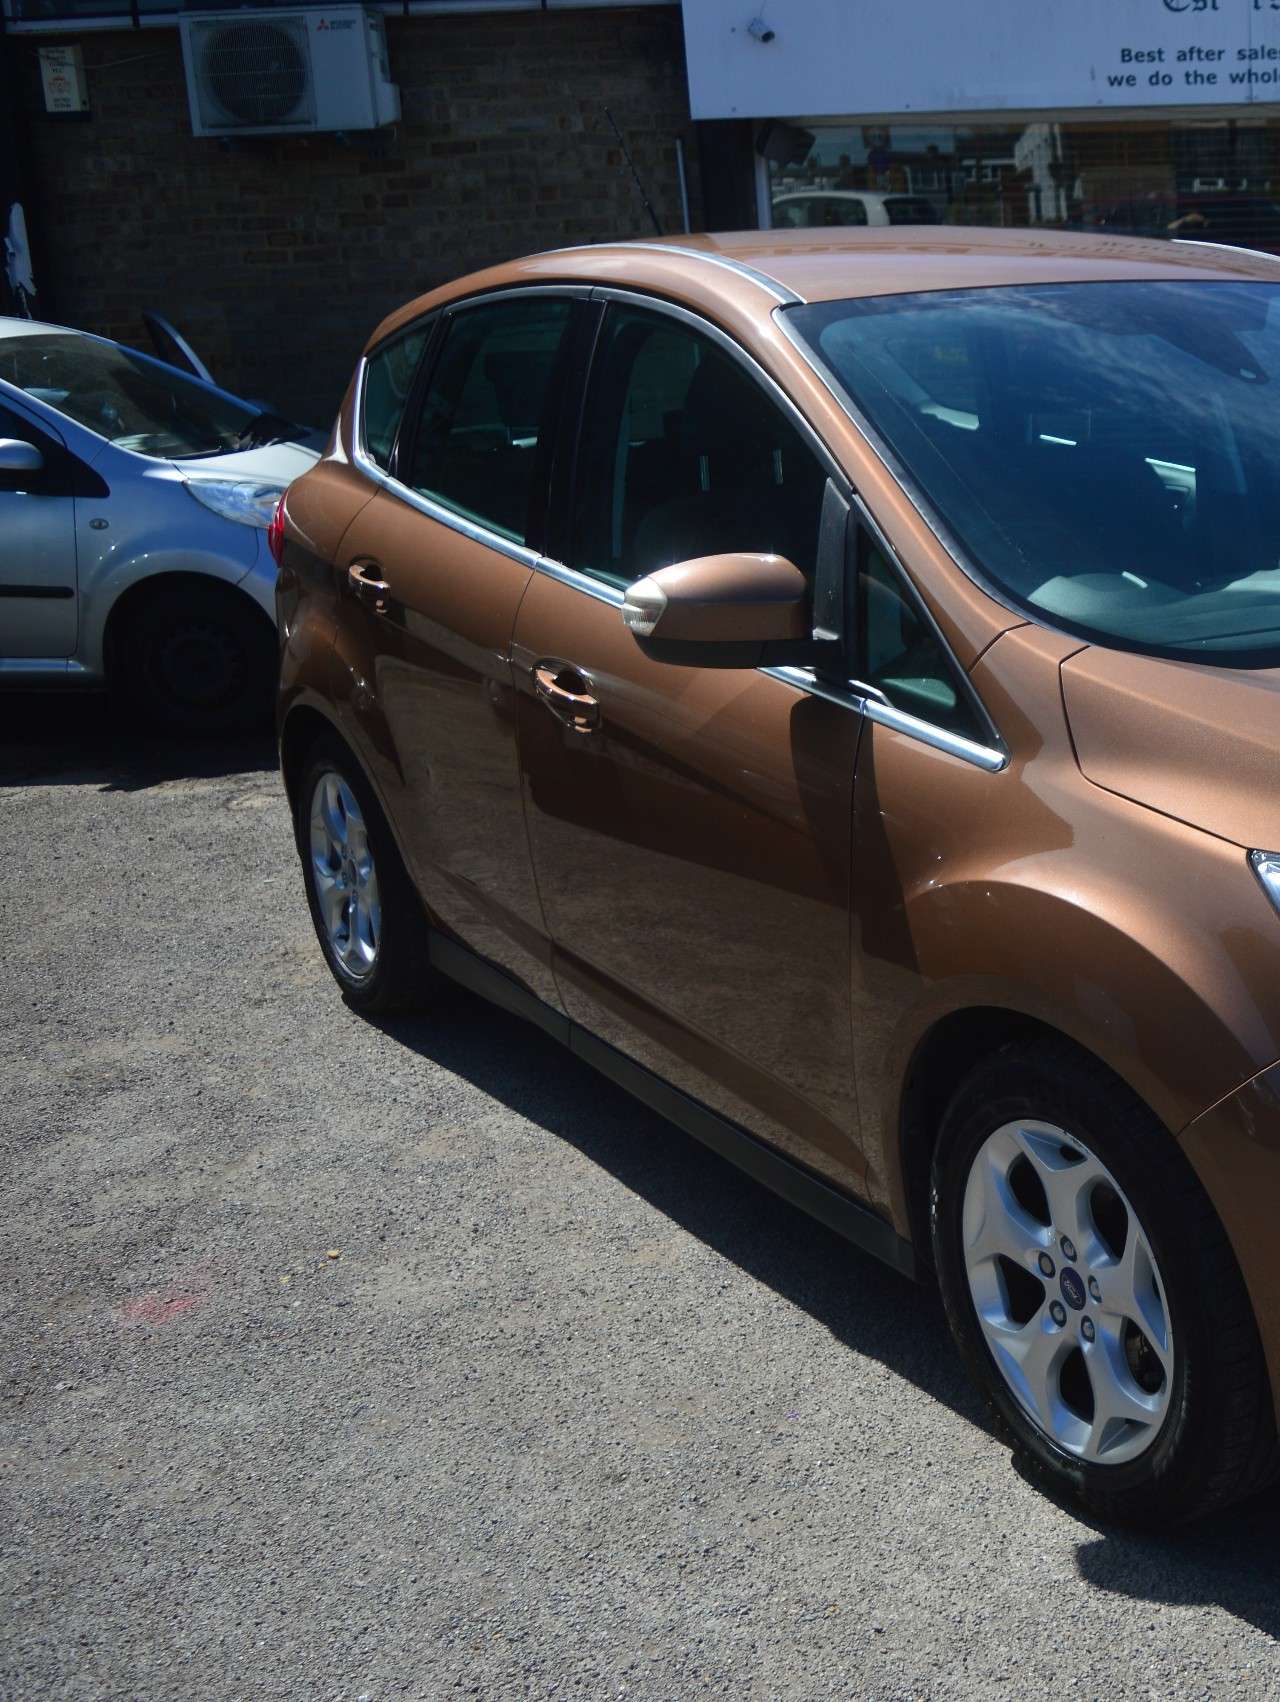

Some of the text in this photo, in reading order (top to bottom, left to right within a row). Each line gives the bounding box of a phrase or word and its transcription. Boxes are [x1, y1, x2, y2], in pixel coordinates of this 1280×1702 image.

[1120, 47, 1165, 64] Best
[1176, 45, 1226, 63] after
[1107, 74, 1138, 88] we
[1147, 70, 1173, 87] do
[1184, 69, 1218, 86] the
